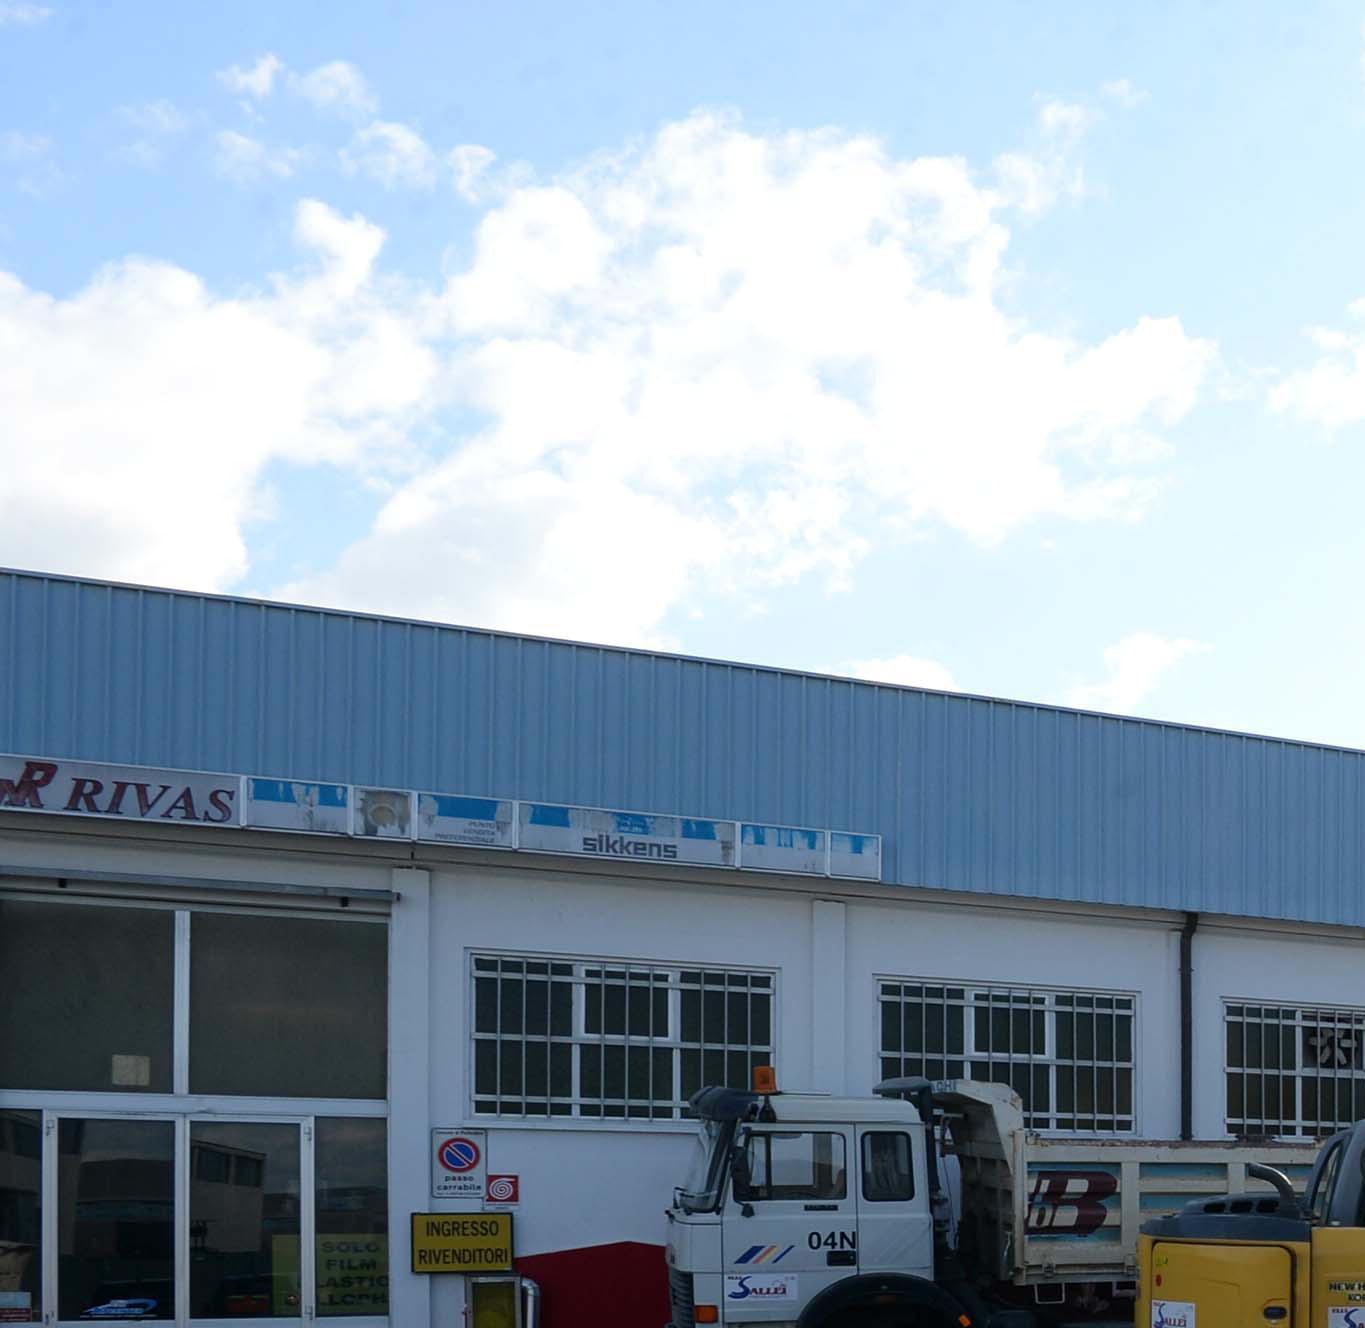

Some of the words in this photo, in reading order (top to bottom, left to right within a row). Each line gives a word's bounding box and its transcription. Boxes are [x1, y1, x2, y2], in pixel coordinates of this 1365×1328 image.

[62, 777, 235, 823] RIVAS
[583, 831, 678, 859] sikkens
[437, 1183, 482, 1191] carrabile
[426, 1220, 499, 1237] INGRESSO
[321, 1241, 380, 1253] SOLO
[808, 1231, 856, 1250] 04N
[326, 1259, 377, 1271] FILM
[418, 1248, 508, 1265] RIVENDITORI
[1328, 1282, 1356, 1291] NEW
